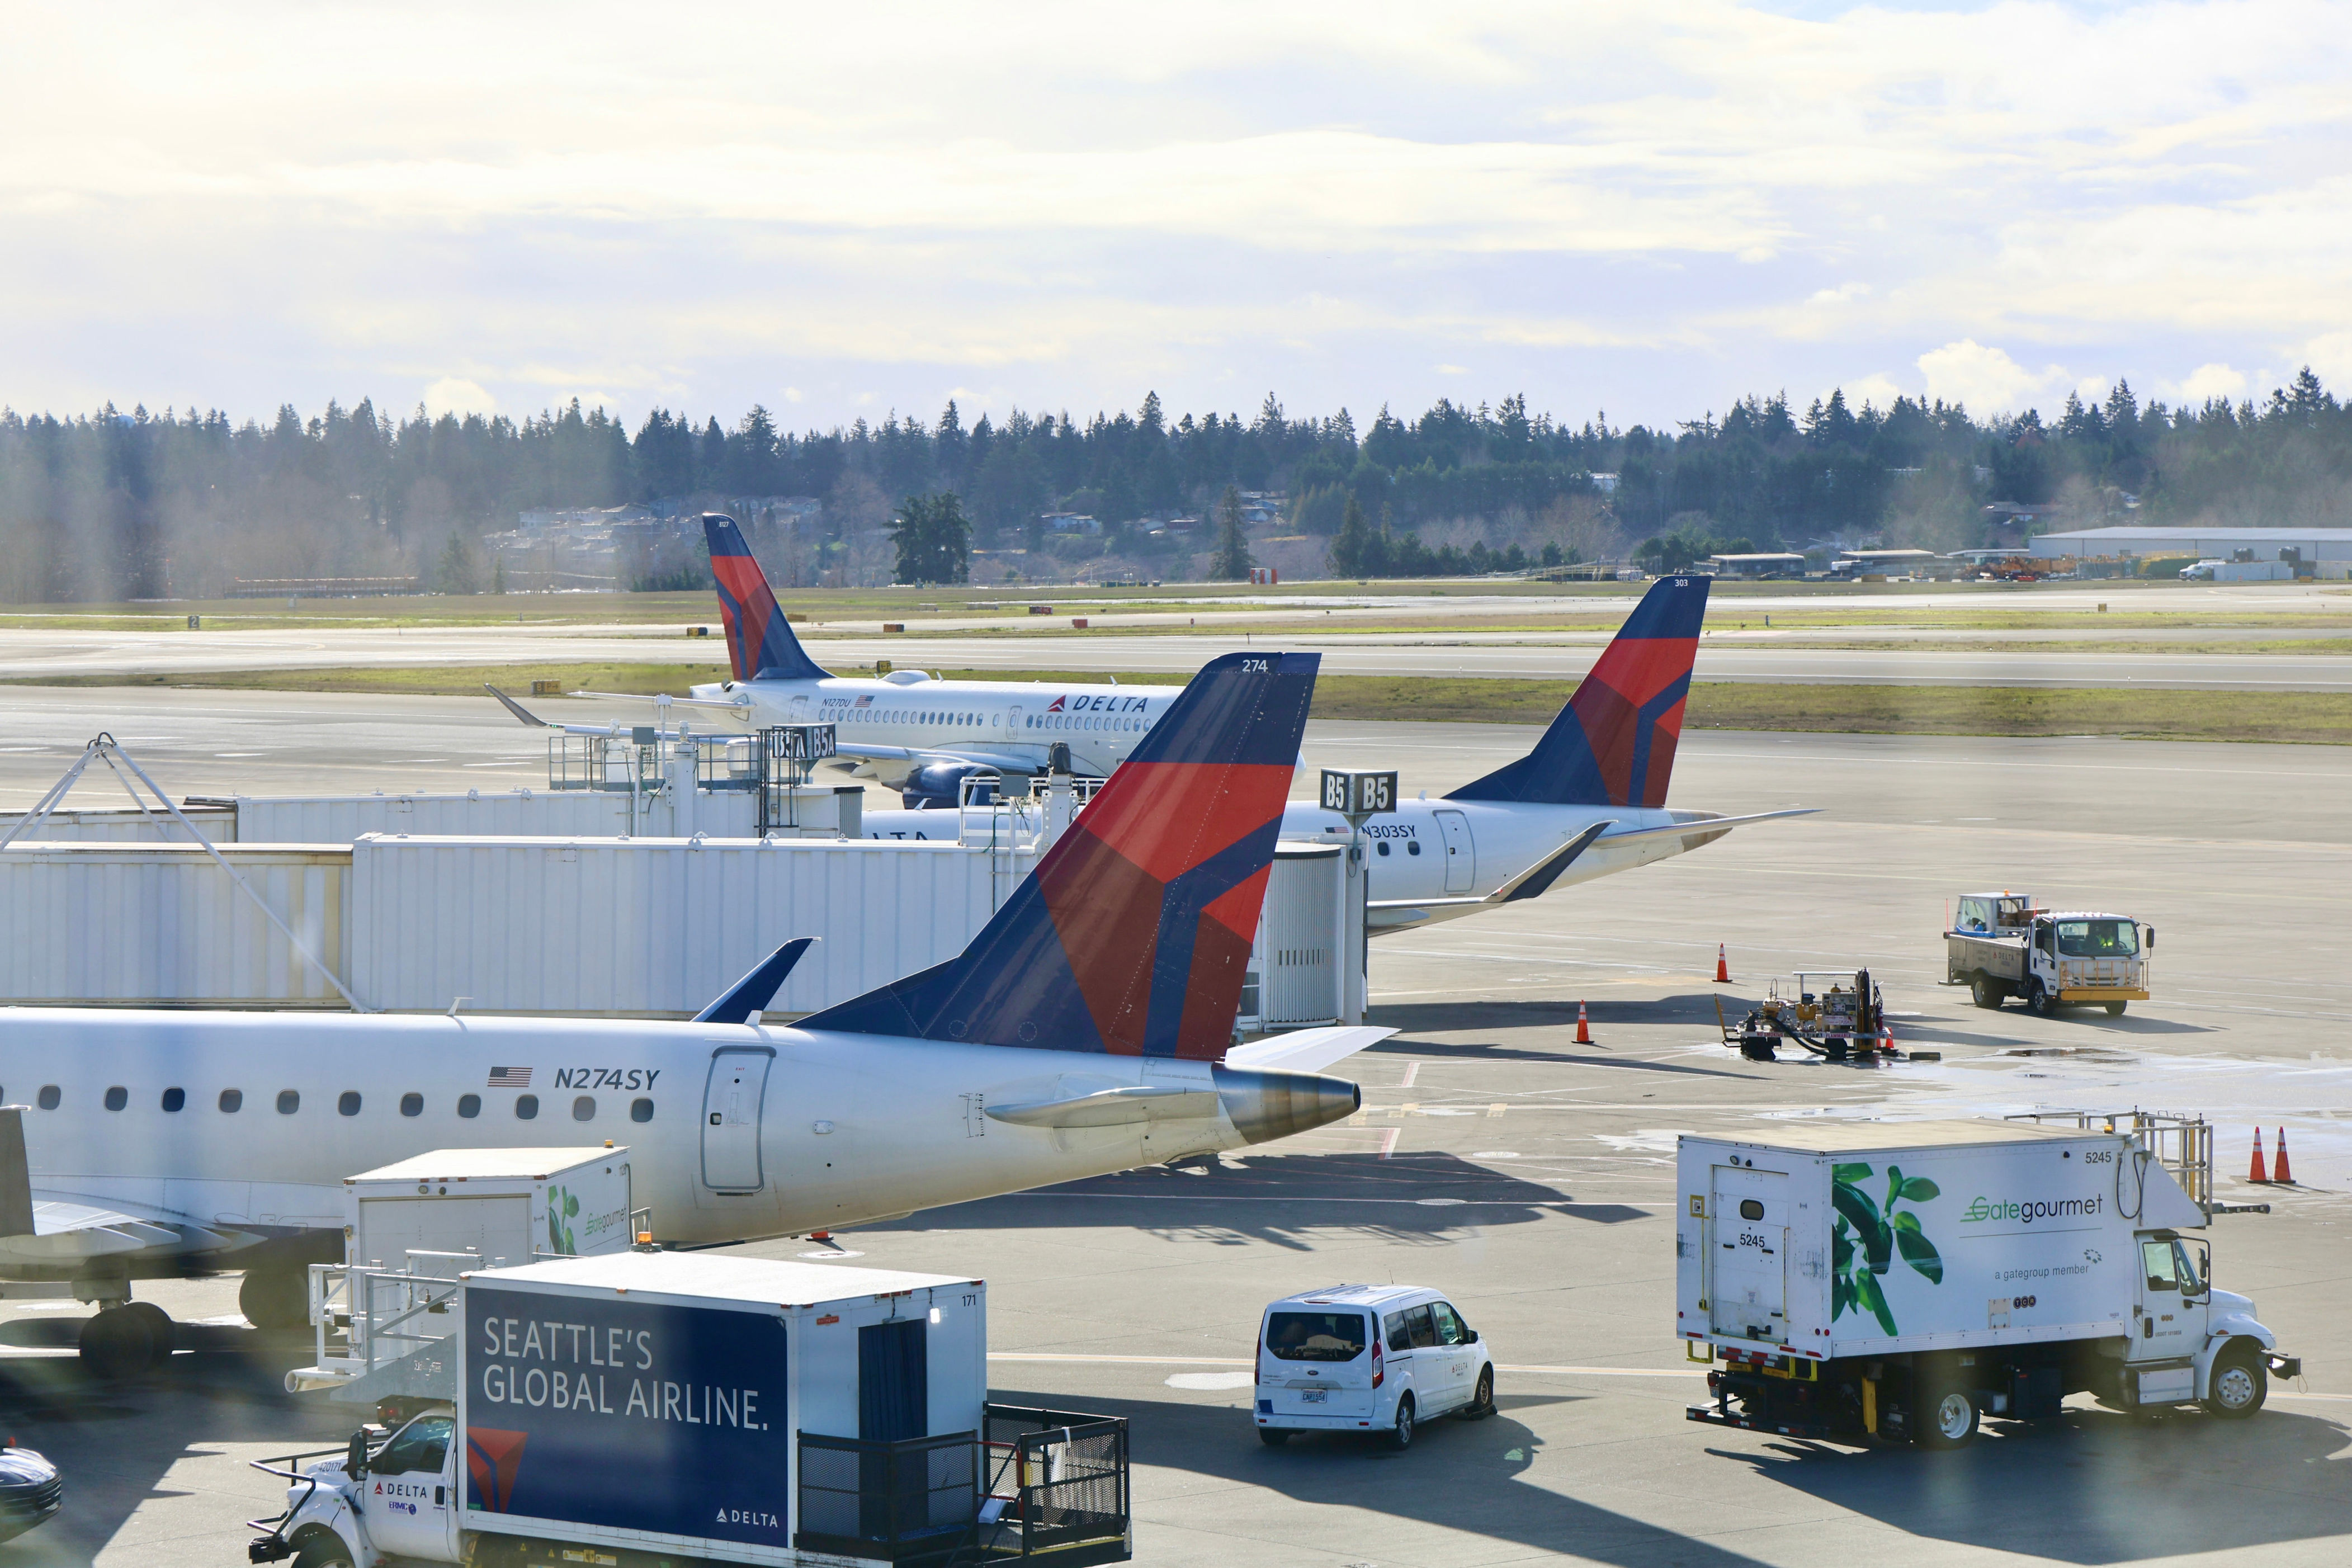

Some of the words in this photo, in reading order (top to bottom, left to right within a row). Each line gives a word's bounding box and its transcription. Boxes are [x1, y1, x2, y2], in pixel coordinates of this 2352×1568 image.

[191, 616, 197, 627] 2
[1242, 659, 1268, 673] 274
[821, 698, 851, 707] N127DU
[1073, 695, 1149, 712] DELTA
[813, 727, 834, 757] B5A
[1326, 774, 1344, 809] B5
[1363, 776, 1388, 809] B5
[1361, 825, 1415, 838] N303SY
[555, 1068, 661, 1091] N274SY
[2084, 1151, 2112, 1164] 5245
[1740, 1233, 1765, 1248] 5245
[1995, 1271, 2000, 1279] a
[2003, 1267, 2049, 1281] gategroup
[2052, 1263, 2089, 1276] member
[962, 1294, 976, 1307] 171
[484, 1317, 653, 1370] SEATTLE'S
[1456, 1362, 1468, 1372] DELTA
[483, 1364, 613, 1415] GLOBAL
[625, 1378, 768, 1431] AIRLINE.
[318, 1462, 342, 1472] 420171
[388, 1483, 427, 1498] DELTA
[389, 1501, 408, 1510] ERMC
[731, 1509, 778, 1528] DELTA
